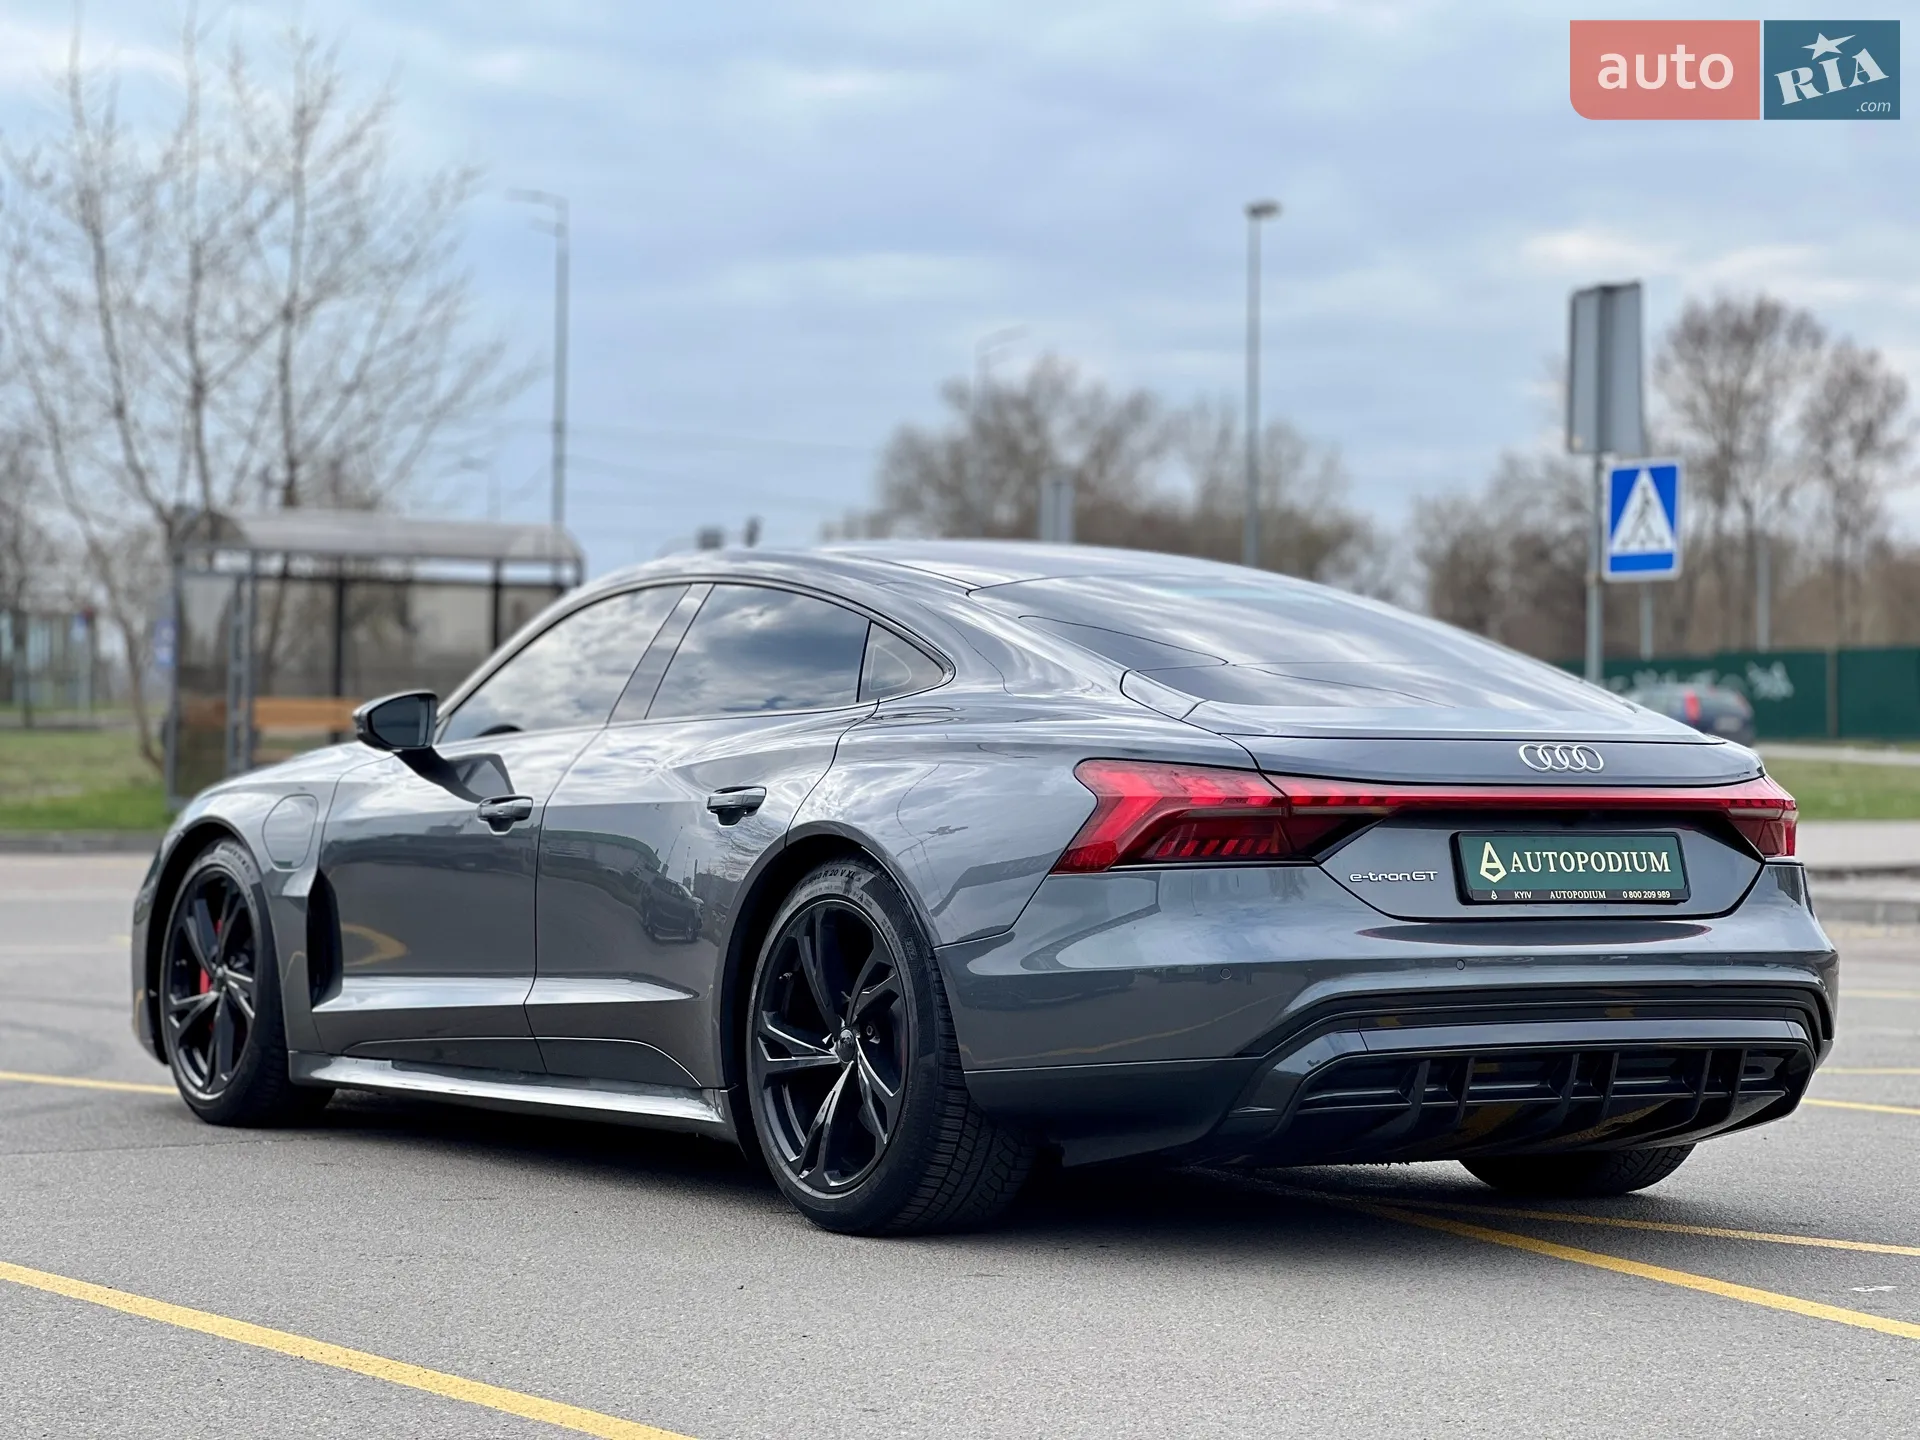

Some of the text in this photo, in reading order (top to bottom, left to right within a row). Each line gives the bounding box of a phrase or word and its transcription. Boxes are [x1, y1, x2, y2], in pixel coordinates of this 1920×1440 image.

[1510, 851, 1671, 873] AUTOPODIUM
[1514, 890, 1532, 899] KYIV
[1549, 890, 1606, 899] AUTOPODIUM
[1622, 890, 1628, 899] 0
[1628, 890, 1642, 899] 800
[1642, 890, 1656, 899] 209
